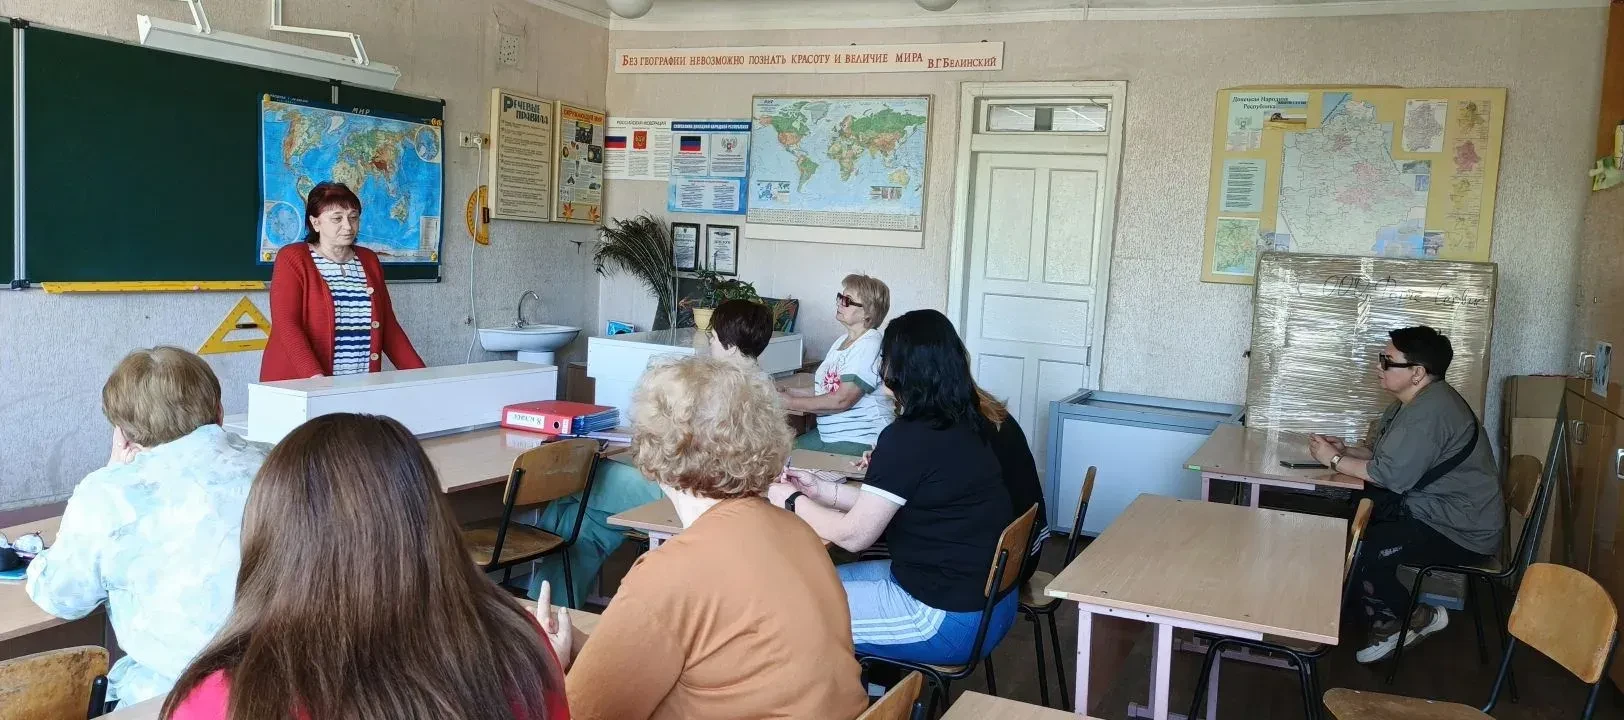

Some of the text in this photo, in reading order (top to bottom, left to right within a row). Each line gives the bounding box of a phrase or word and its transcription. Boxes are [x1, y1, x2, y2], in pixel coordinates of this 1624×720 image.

[640, 56, 686, 66] ГЕОГРАФИИ
[689, 55, 745, 66] НЕВОЗМОЖНО
[748, 54, 787, 65] ПОЗНАТЬ
[791, 54, 831, 64] КРАСОТУ
[834, 54, 842, 64] И
[845, 53, 889, 64] ВЕЛИЧИЕ
[895, 52, 924, 63] МИРА
[351, 106, 371, 114] МИР
